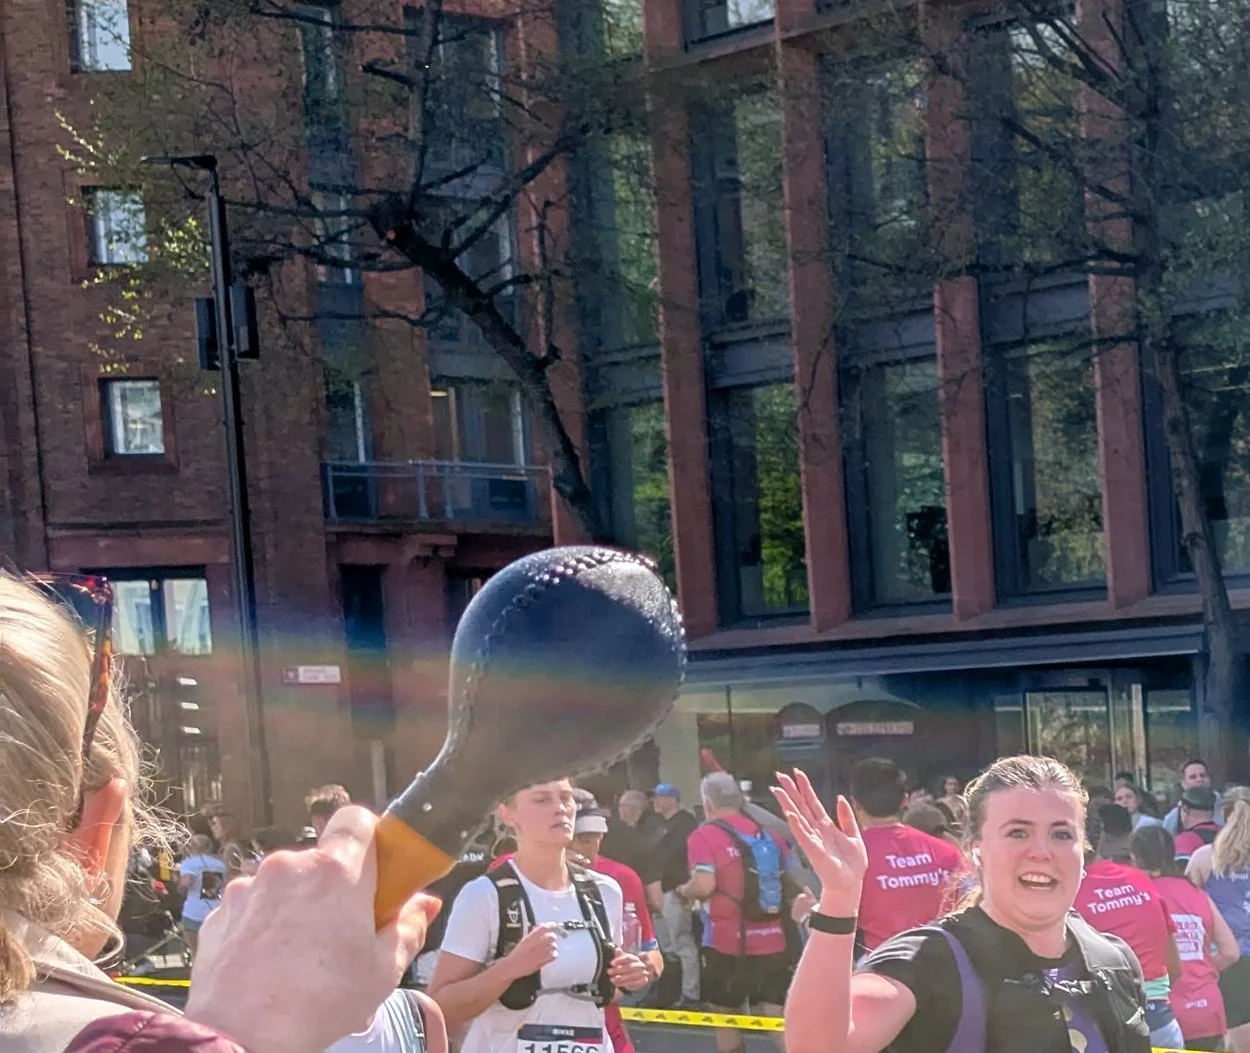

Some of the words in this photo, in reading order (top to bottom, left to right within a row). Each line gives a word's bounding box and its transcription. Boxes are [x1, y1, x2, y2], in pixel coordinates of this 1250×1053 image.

[885, 853, 932, 868] Team
[876, 868, 950, 890] Tommy's
[1094, 884, 1135, 900] Team
[1087, 892, 1151, 914] Tommy's
